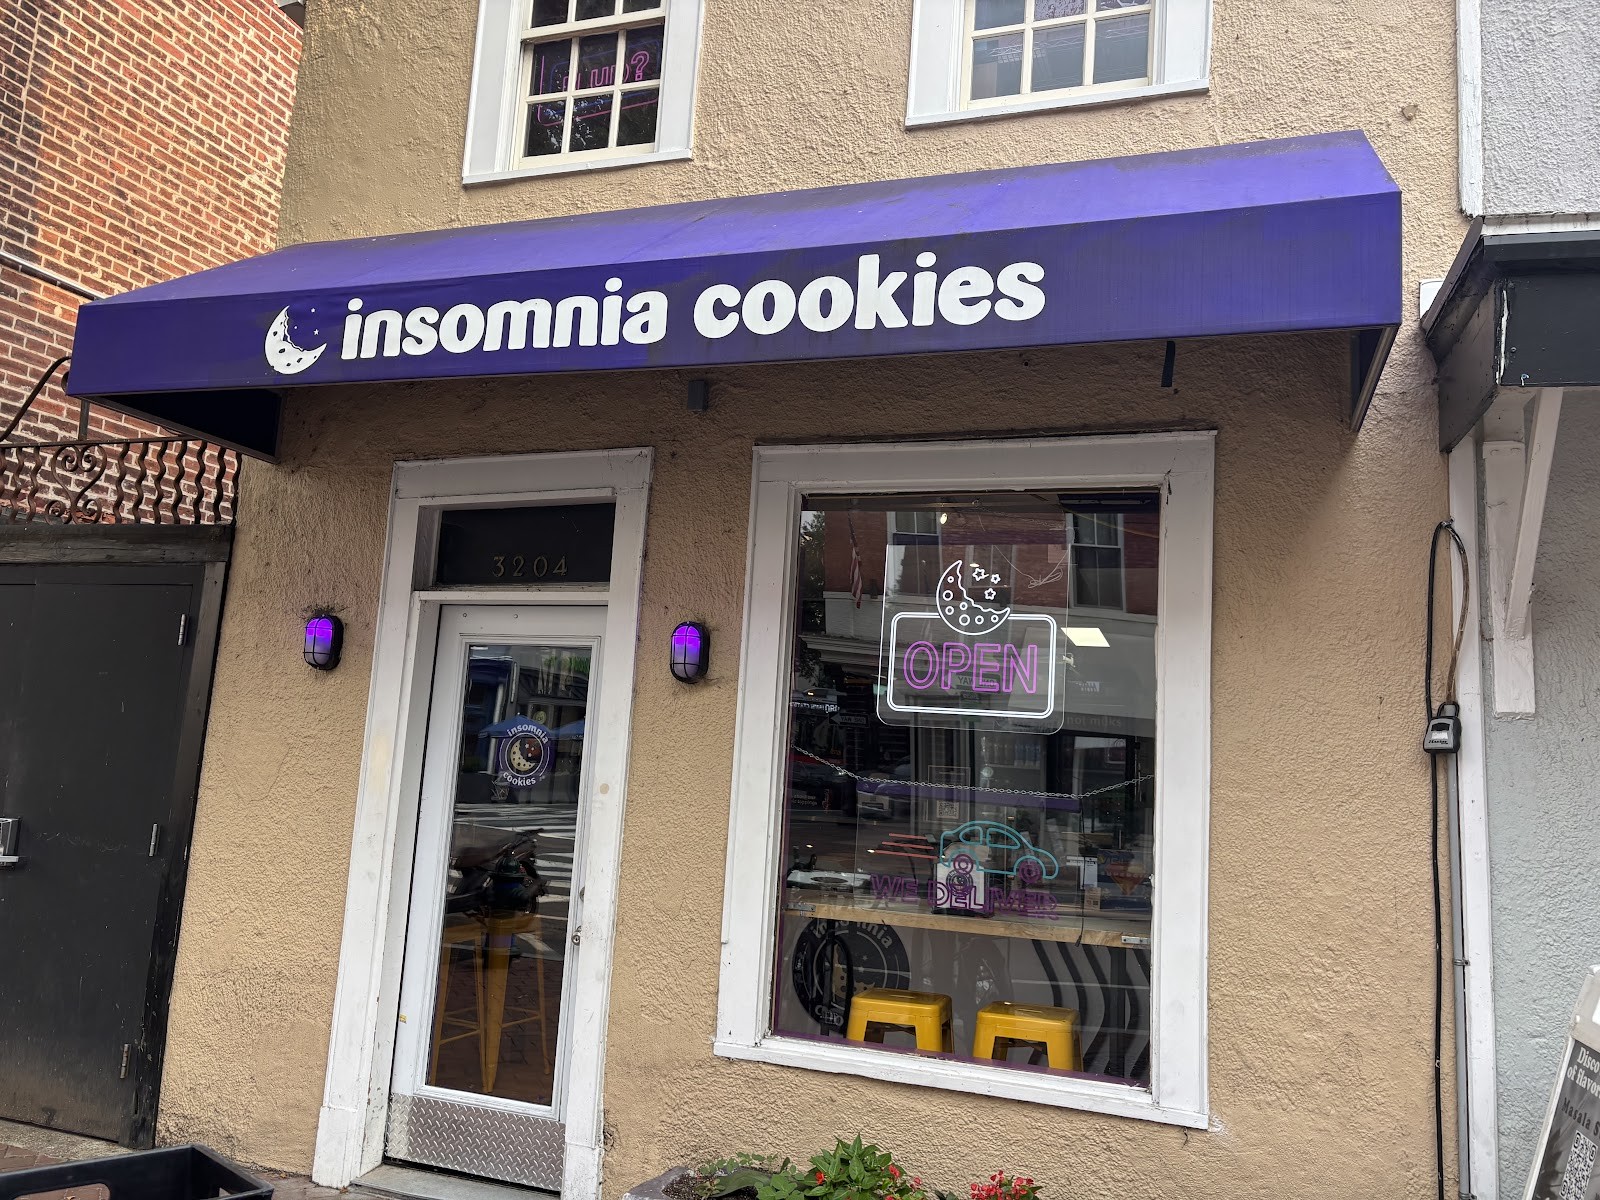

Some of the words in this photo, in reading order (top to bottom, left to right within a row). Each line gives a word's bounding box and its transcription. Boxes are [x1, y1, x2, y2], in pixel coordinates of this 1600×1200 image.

[341, 277, 668, 359] insomnia
[694, 252, 1045, 338] cookies
[492, 556, 568, 577] 3204
[903, 640, 1038, 694] OPEN
[507, 724, 549, 744] insomnia
[503, 772, 536, 786] cookies
[870, 874, 919, 901] WE
[1567, 1065, 1577, 1081] of
[1576, 1068, 1600, 1098] flavor
[1561, 1097, 1591, 1130] Masala
